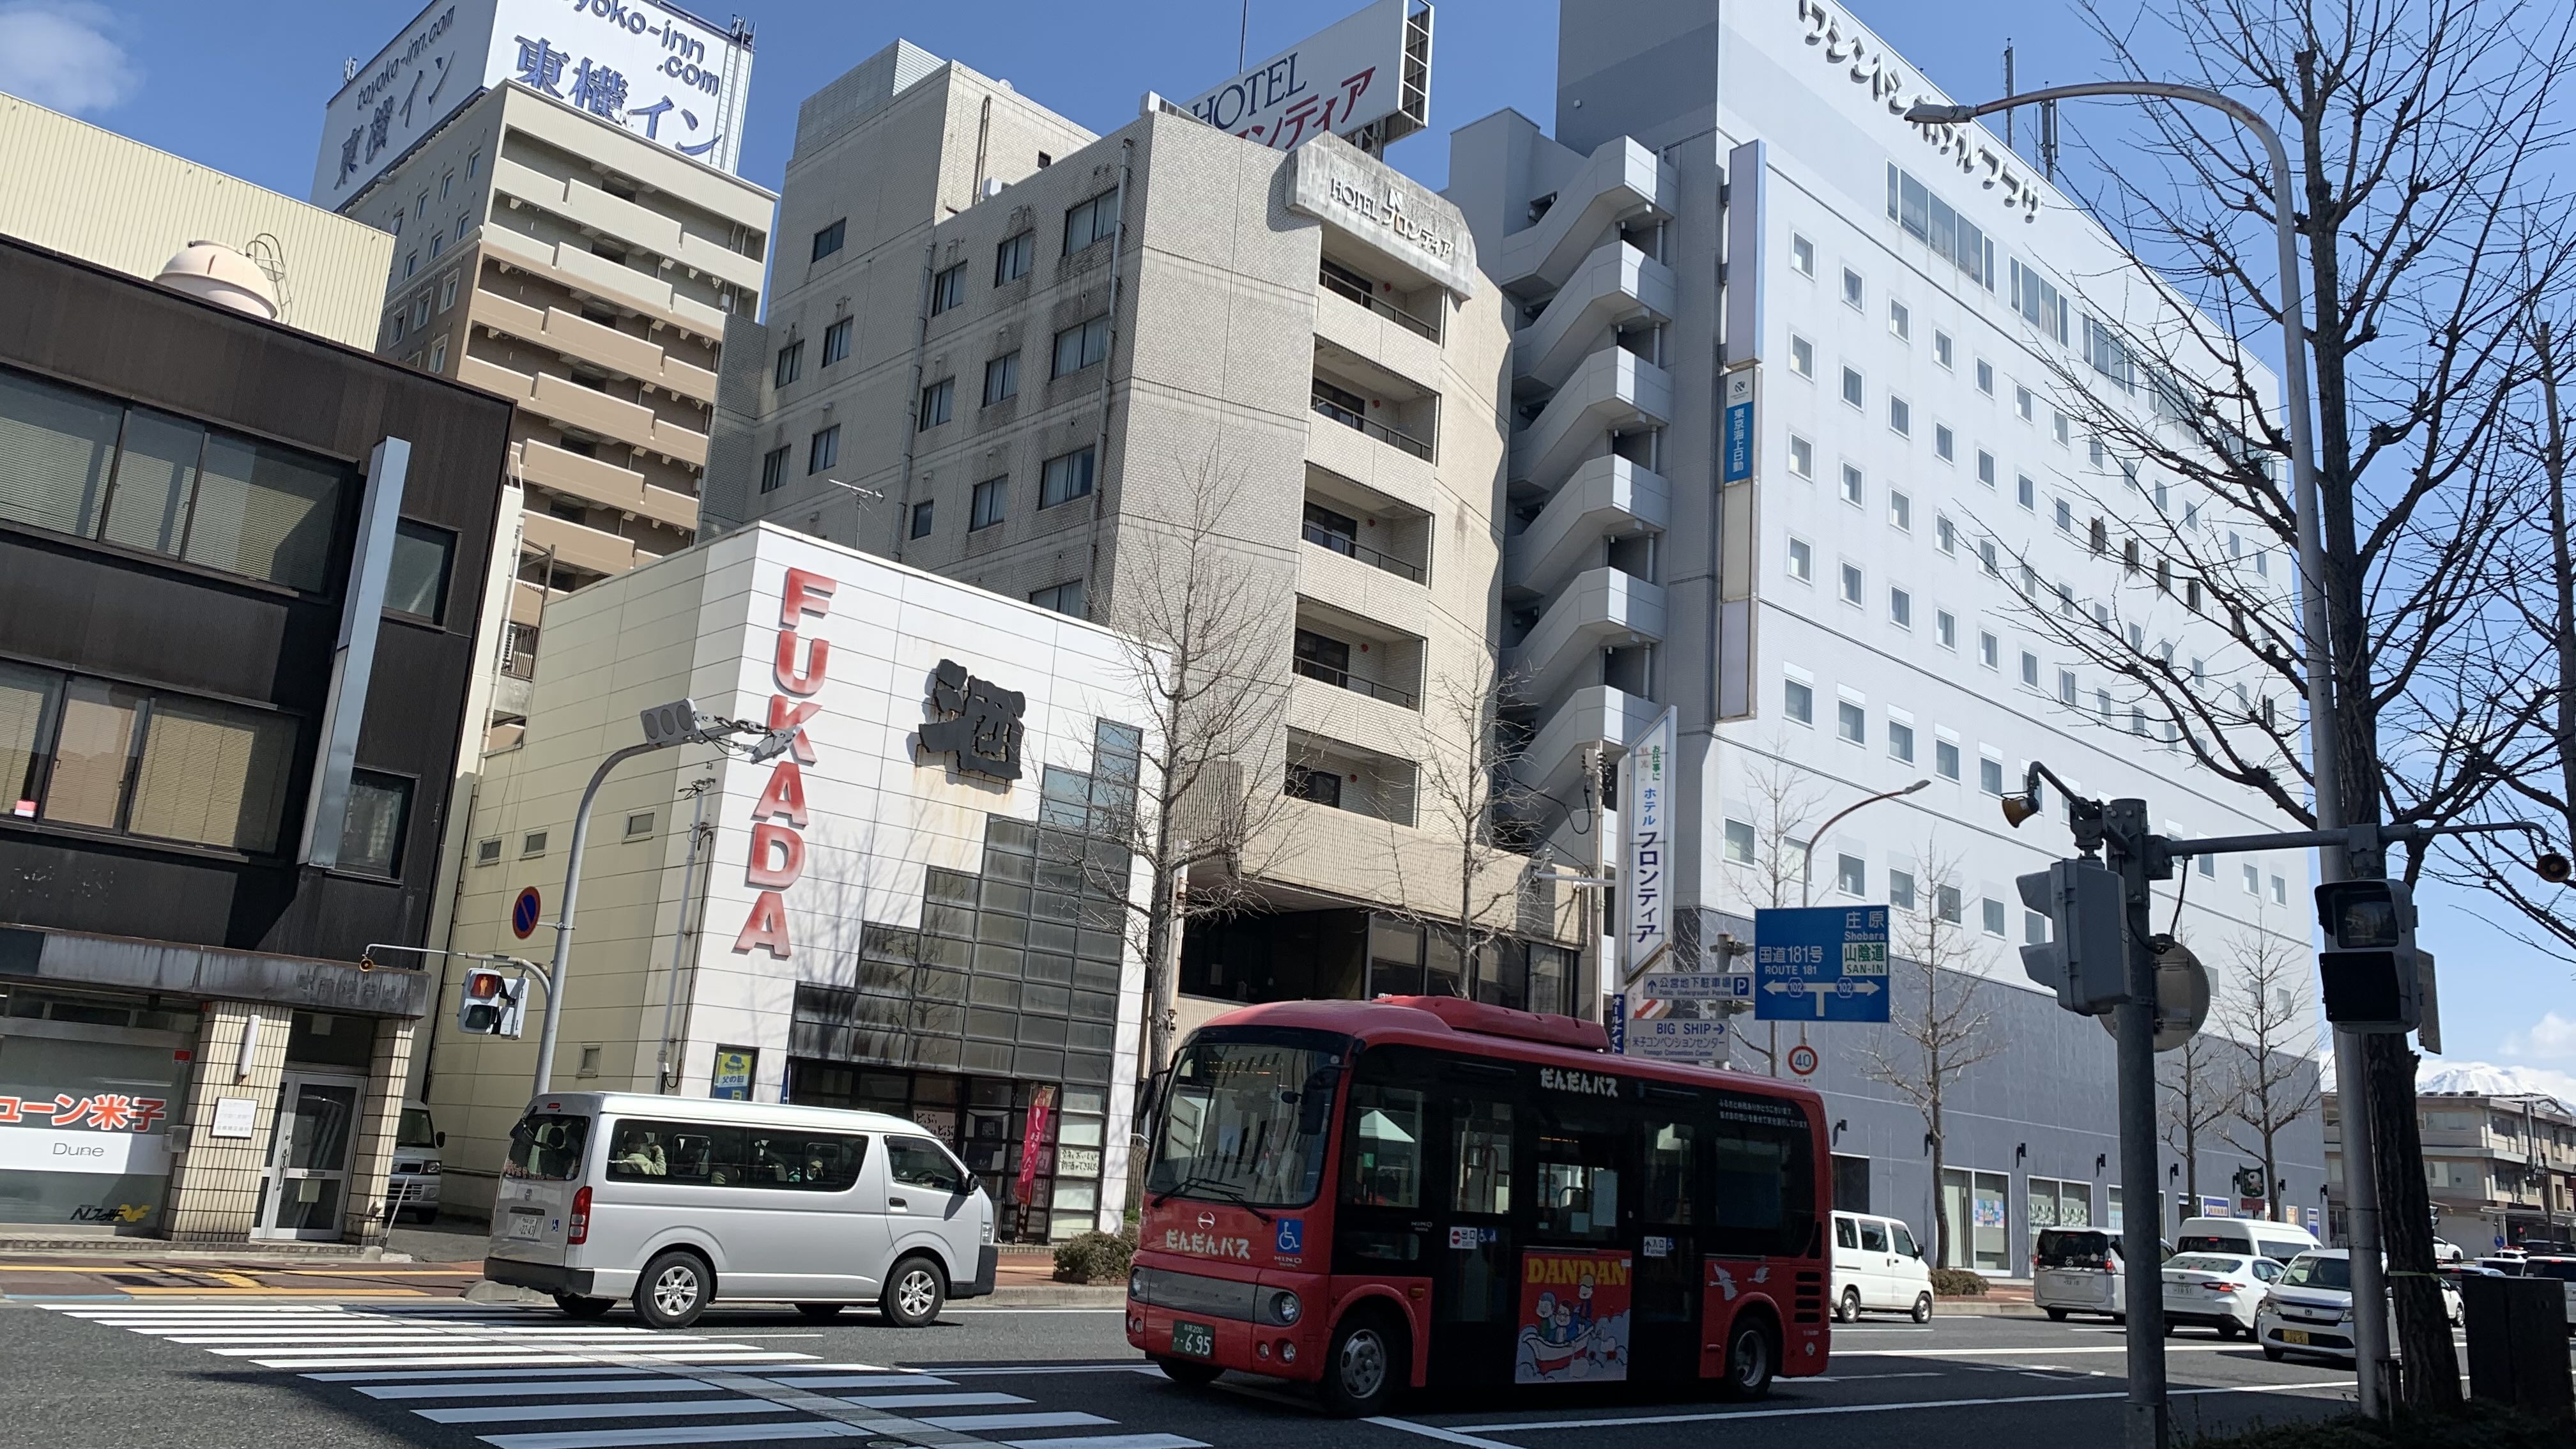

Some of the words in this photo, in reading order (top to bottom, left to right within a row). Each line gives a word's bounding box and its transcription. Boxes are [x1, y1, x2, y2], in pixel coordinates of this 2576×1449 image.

[357, 5, 456, 111] toyoko-inn.com
[514, 35, 723, 155] 東横イン
[1191, 52, 1307, 129] HOTEL
[1331, 178, 1380, 221] HOTEL
[1733, 408, 1745, 473] 東京海上日動
[732, 567, 837, 957] FUKADA
[1844, 931, 1885, 940] Shobara
[1759, 946, 1823, 963] 国道181号
[1844, 944, 1885, 962] 山陰道
[1765, 965, 1798, 975] ROUTE
[1803, 965, 1817, 975] 181
[1846, 963, 1883, 974] SAN-IN
[1789, 981, 1802, 992] 102
[1839, 982, 1852, 993] 102
[1611, 997, 1623, 1054] オールナイト
[1657, 1023, 1676, 1035] BIG
[1683, 1023, 1712, 1035] SHIP
[1795, 1054, 1812, 1068] 40
[723, 1075, 745, 1084] 父の日
[1540, 1068, 1619, 1098] だんだんバス
[52, 1142, 104, 1157] Dune
[1165, 1229, 1250, 1261] だんだんバス
[1274, 1255, 1302, 1264] HINO
[1527, 1258, 1627, 1286] DANDAN
